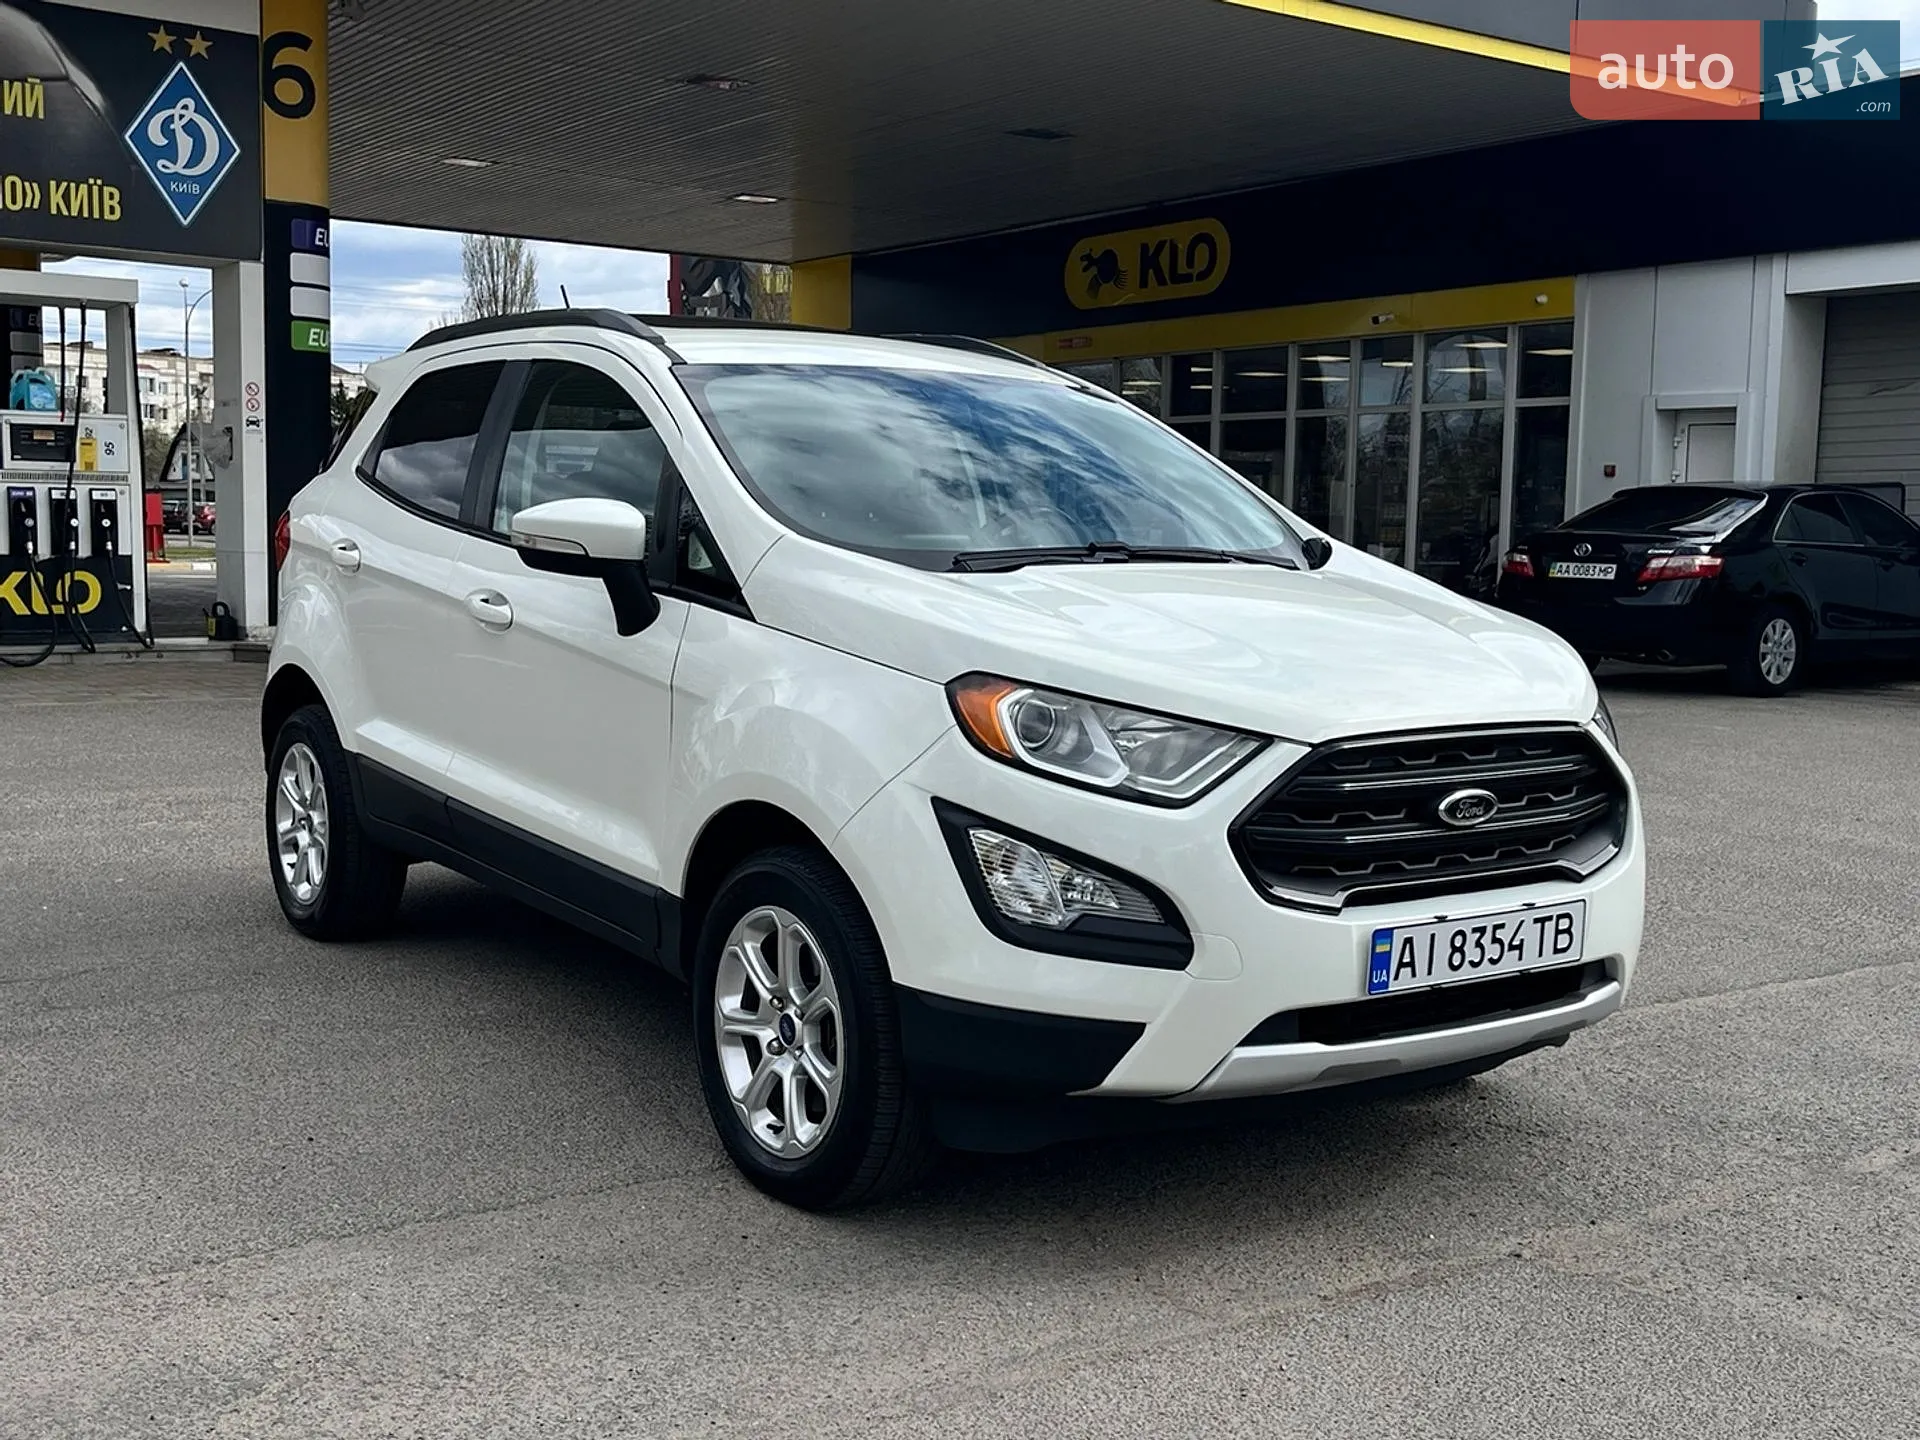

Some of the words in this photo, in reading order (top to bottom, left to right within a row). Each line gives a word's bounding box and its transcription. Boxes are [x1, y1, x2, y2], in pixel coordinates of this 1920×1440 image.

[262, 31, 316, 119] 6
[3, 77, 45, 120] ИЙ
[0, 174, 42, 212] О»
[49, 177, 122, 222] КИЇВ
[170, 181, 201, 195] КИЇВ
[1139, 232, 1218, 289] KLO
[104, 441, 115, 456] 95
[1557, 564, 1571, 576] AA
[1573, 564, 1597, 577] 0083
[1598, 565, 1615, 578] MP
[1456, 798, 1486, 818] Ford
[1393, 932, 1436, 981] AI
[1447, 919, 1526, 972] 8354
[1533, 911, 1574, 958] TB
[1372, 971, 1388, 984] UA
